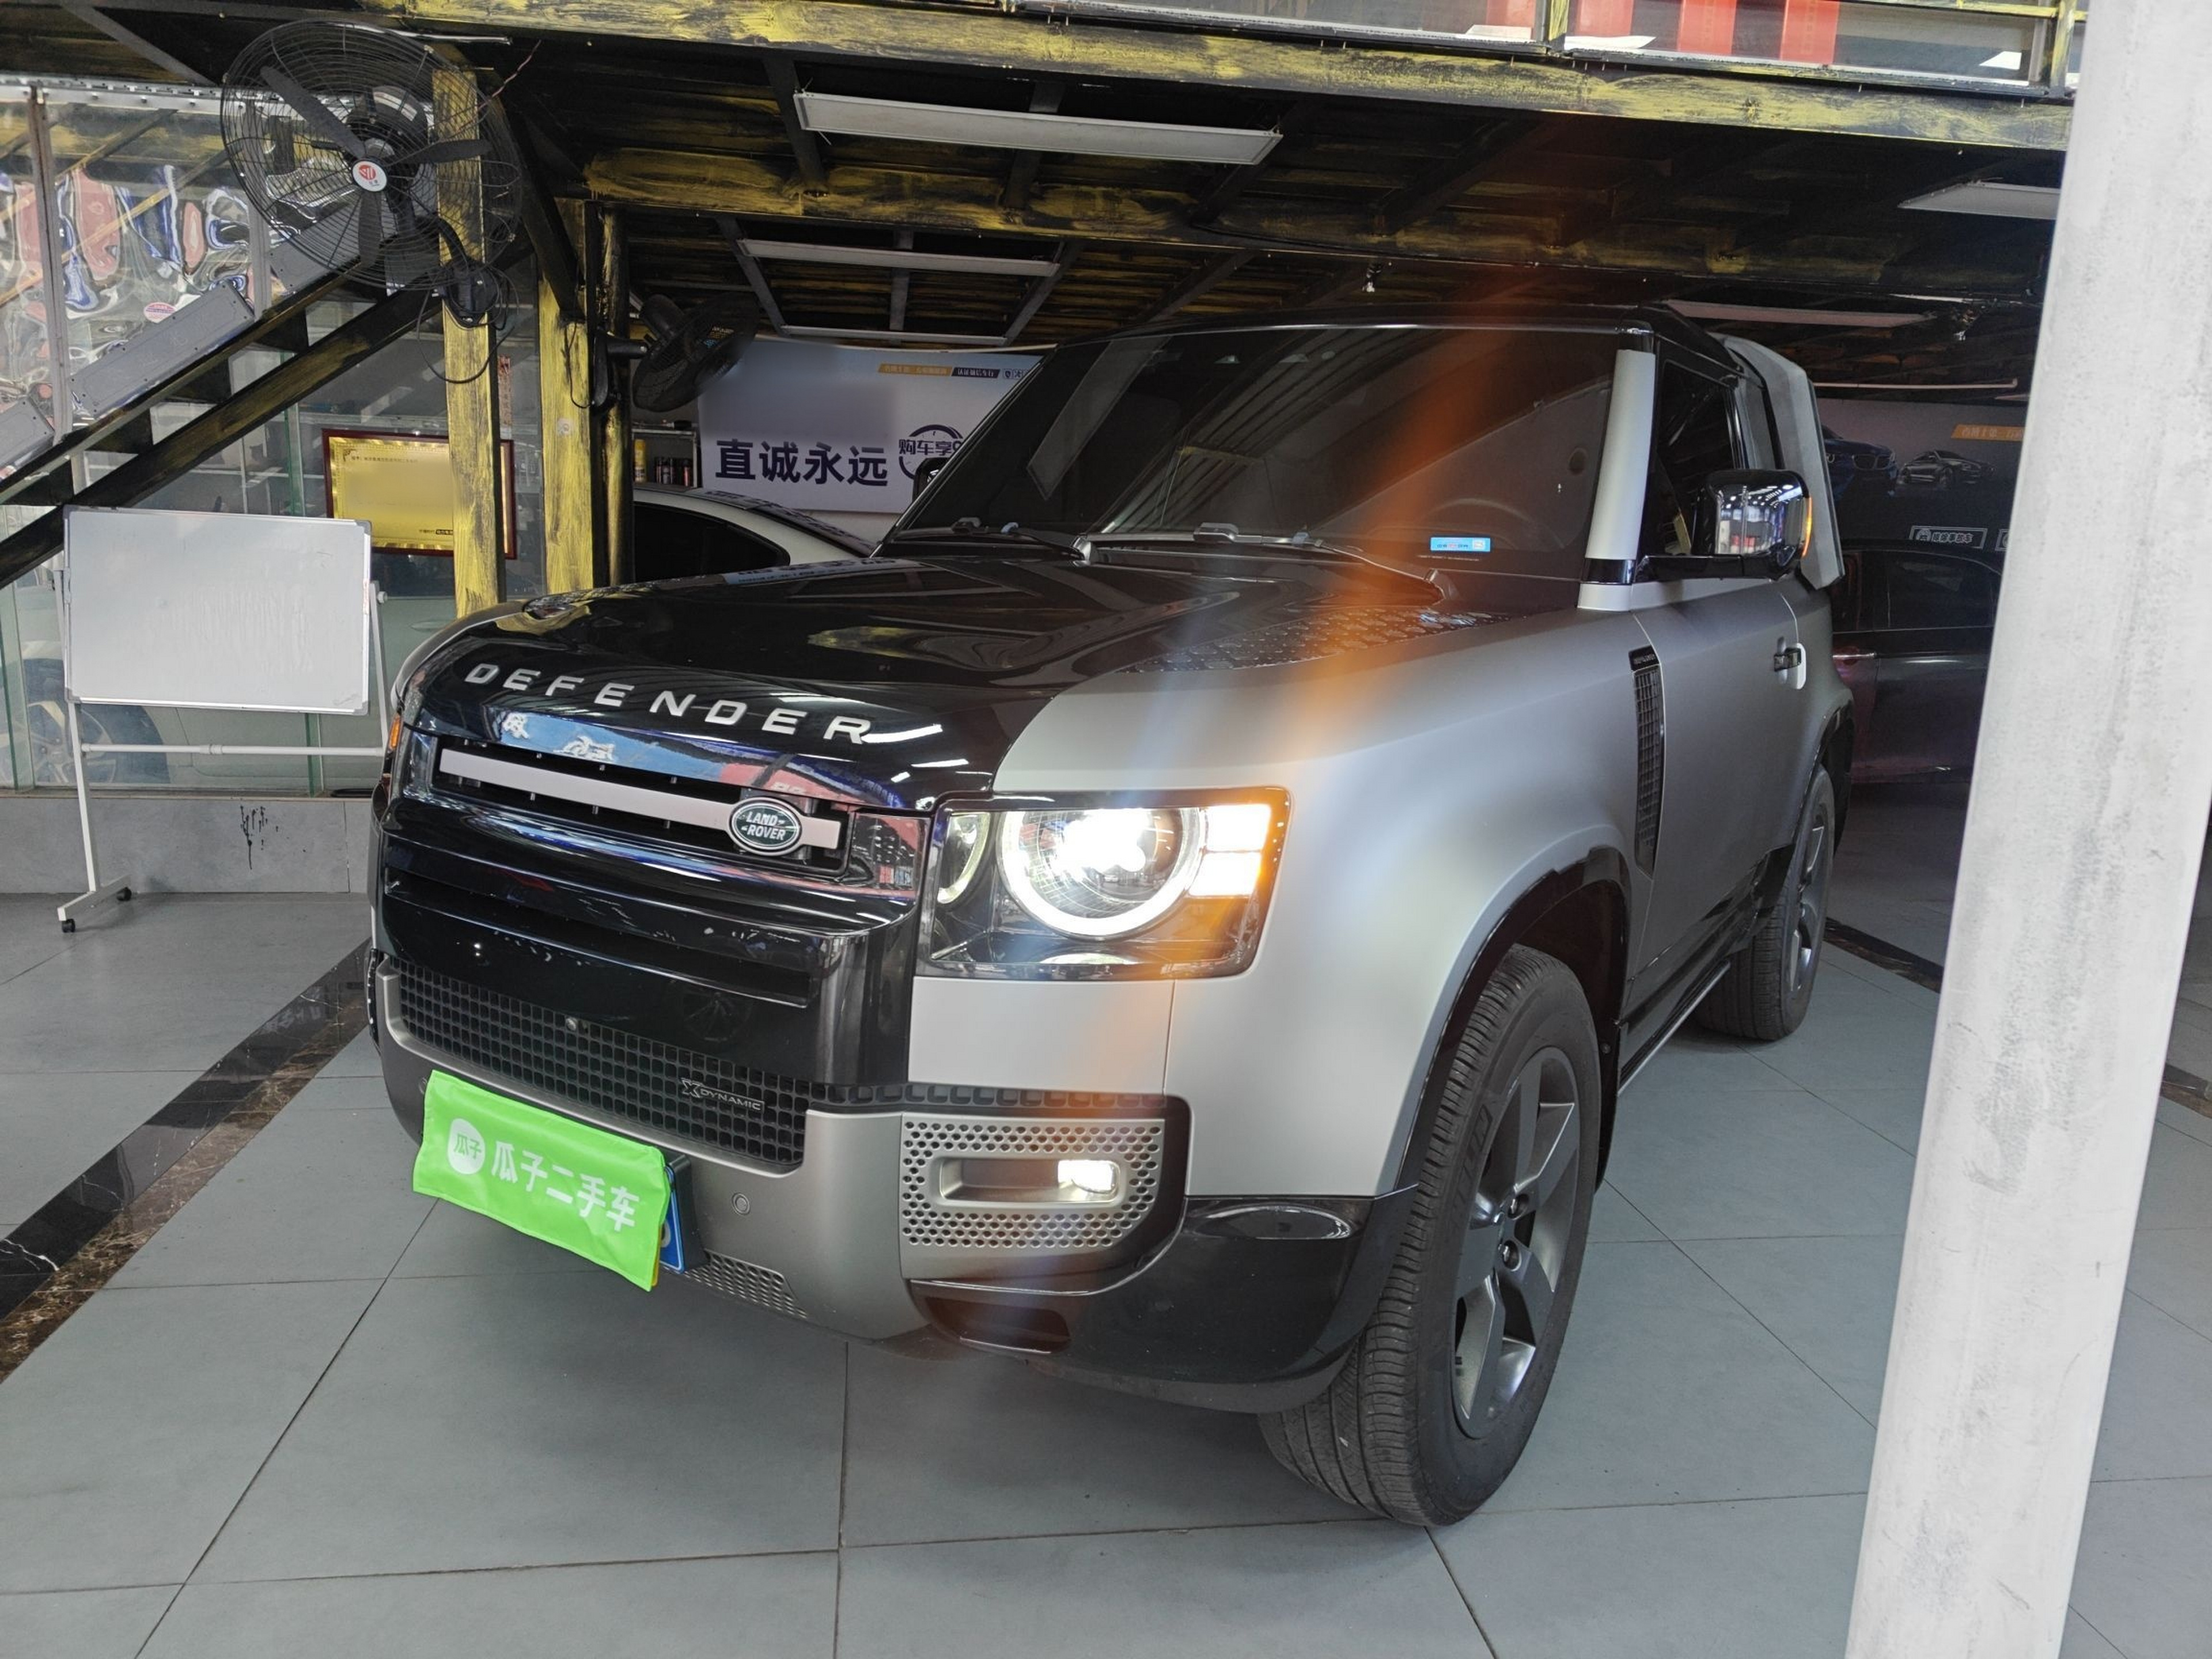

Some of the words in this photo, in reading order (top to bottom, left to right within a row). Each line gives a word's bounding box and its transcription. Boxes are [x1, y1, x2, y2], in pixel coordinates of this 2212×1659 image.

[715, 438, 889, 487] 直诚永远
[464, 662, 872, 744] DEFENDER
[746, 811, 778, 826] LAND
[747, 824, 786, 840] ROVER
[453, 1132, 482, 1160] 瓜子
[491, 1140, 640, 1232] 瓜子二手车
